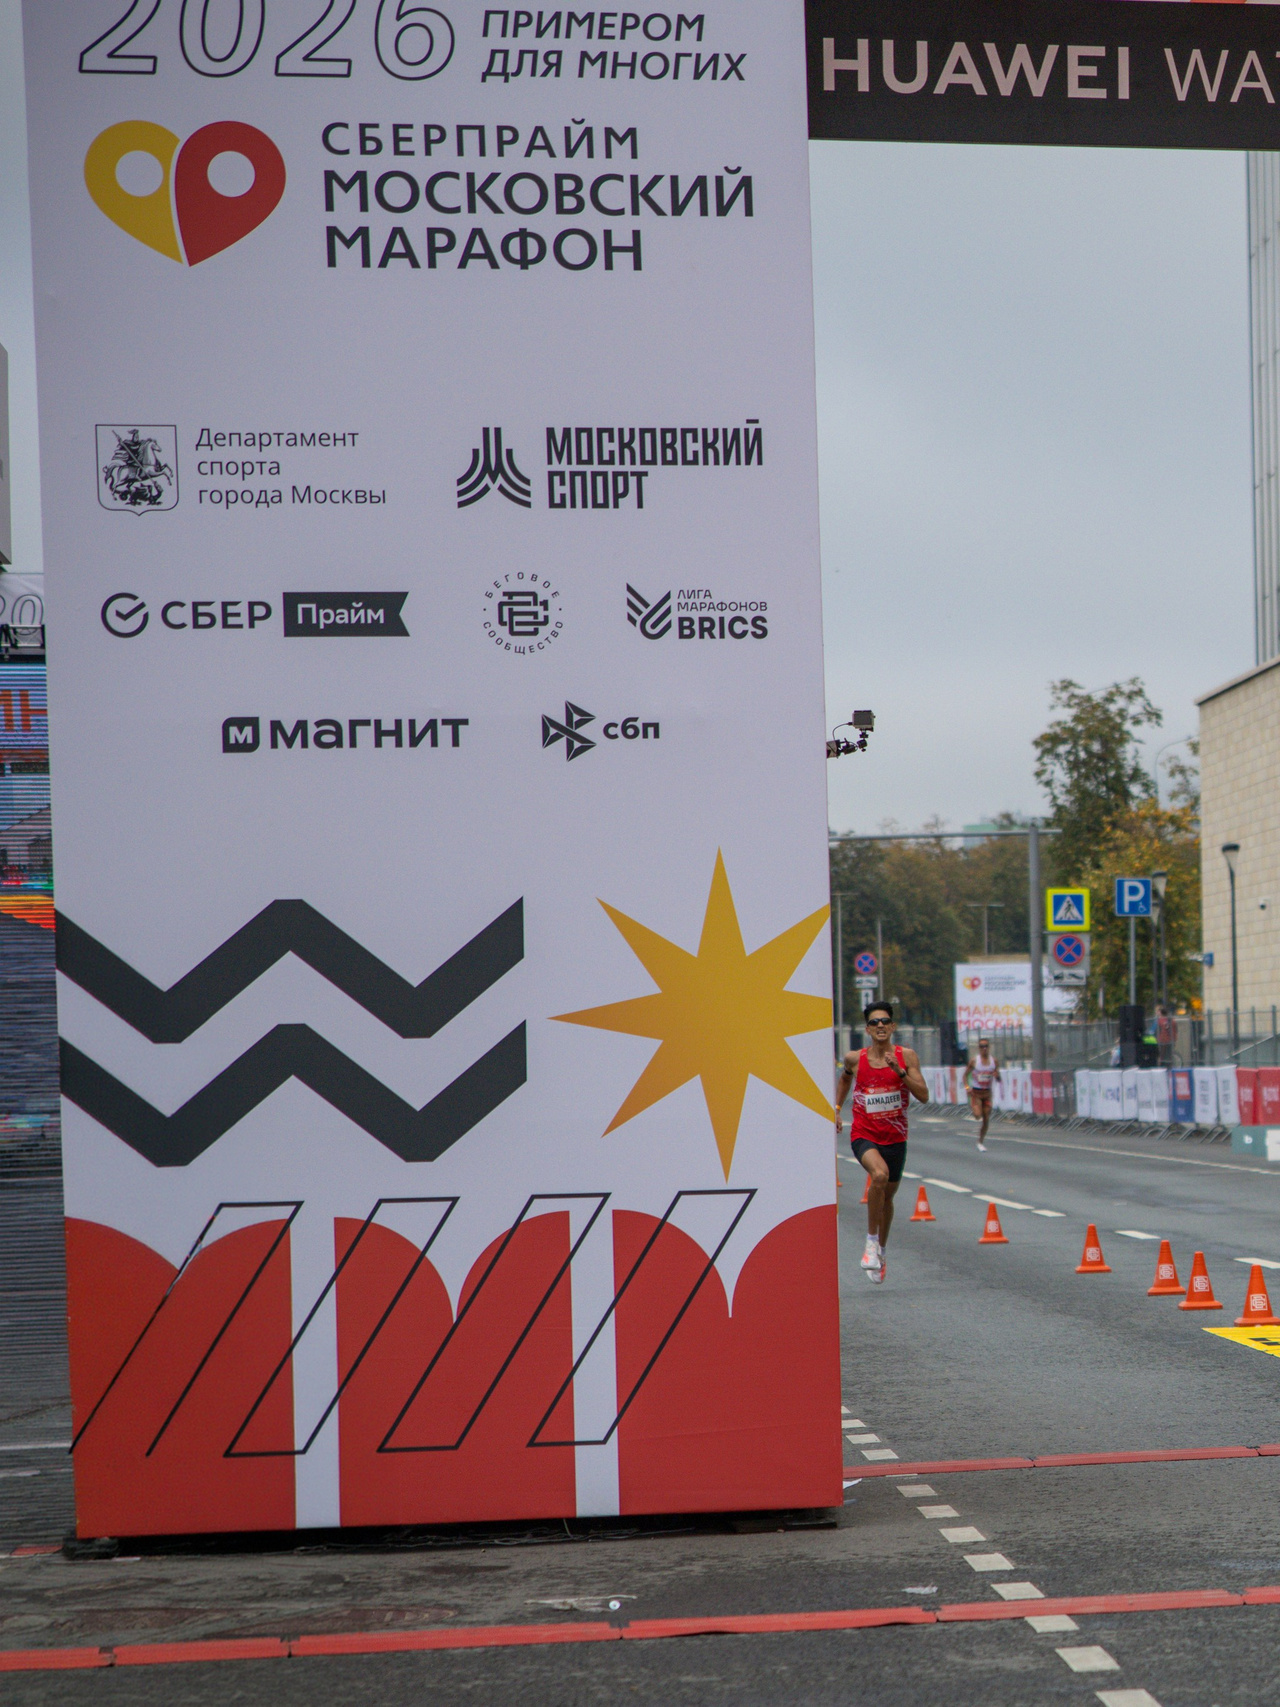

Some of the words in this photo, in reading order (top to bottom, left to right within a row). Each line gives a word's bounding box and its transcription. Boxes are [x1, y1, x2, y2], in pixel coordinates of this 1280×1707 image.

[482, 10, 705, 42] ПРИМЕРОМ
[481, 49, 563, 83] ДЛЯ
[577, 50, 747, 81] МНОГИХ
[821, 37, 1130, 99] HUAWEI
[321, 118, 638, 160] СБЕРПРАЙМ
[323, 166, 754, 217] МОСКОВСКИЙ
[325, 226, 642, 271] МАРАФОН
[195, 427, 359, 452] Департамент
[546, 419, 763, 466] МОСКОВСКИЙ
[197, 460, 281, 480] спорта
[198, 487, 283, 509] города
[291, 485, 386, 504] Москвы
[547, 470, 648, 509] СПОРТ
[484, 572, 561, 599] БЕГОВОЕ
[677, 589, 712, 600] ЛИГА
[161, 601, 272, 630] СБЕР
[297, 602, 385, 629] Прайм
[677, 601, 768, 612] МАРАФОНОВ
[482, 620, 564, 655] СООБЩЕСТВО
[678, 615, 768, 640] BRICS
[603, 716, 660, 740] сбп
